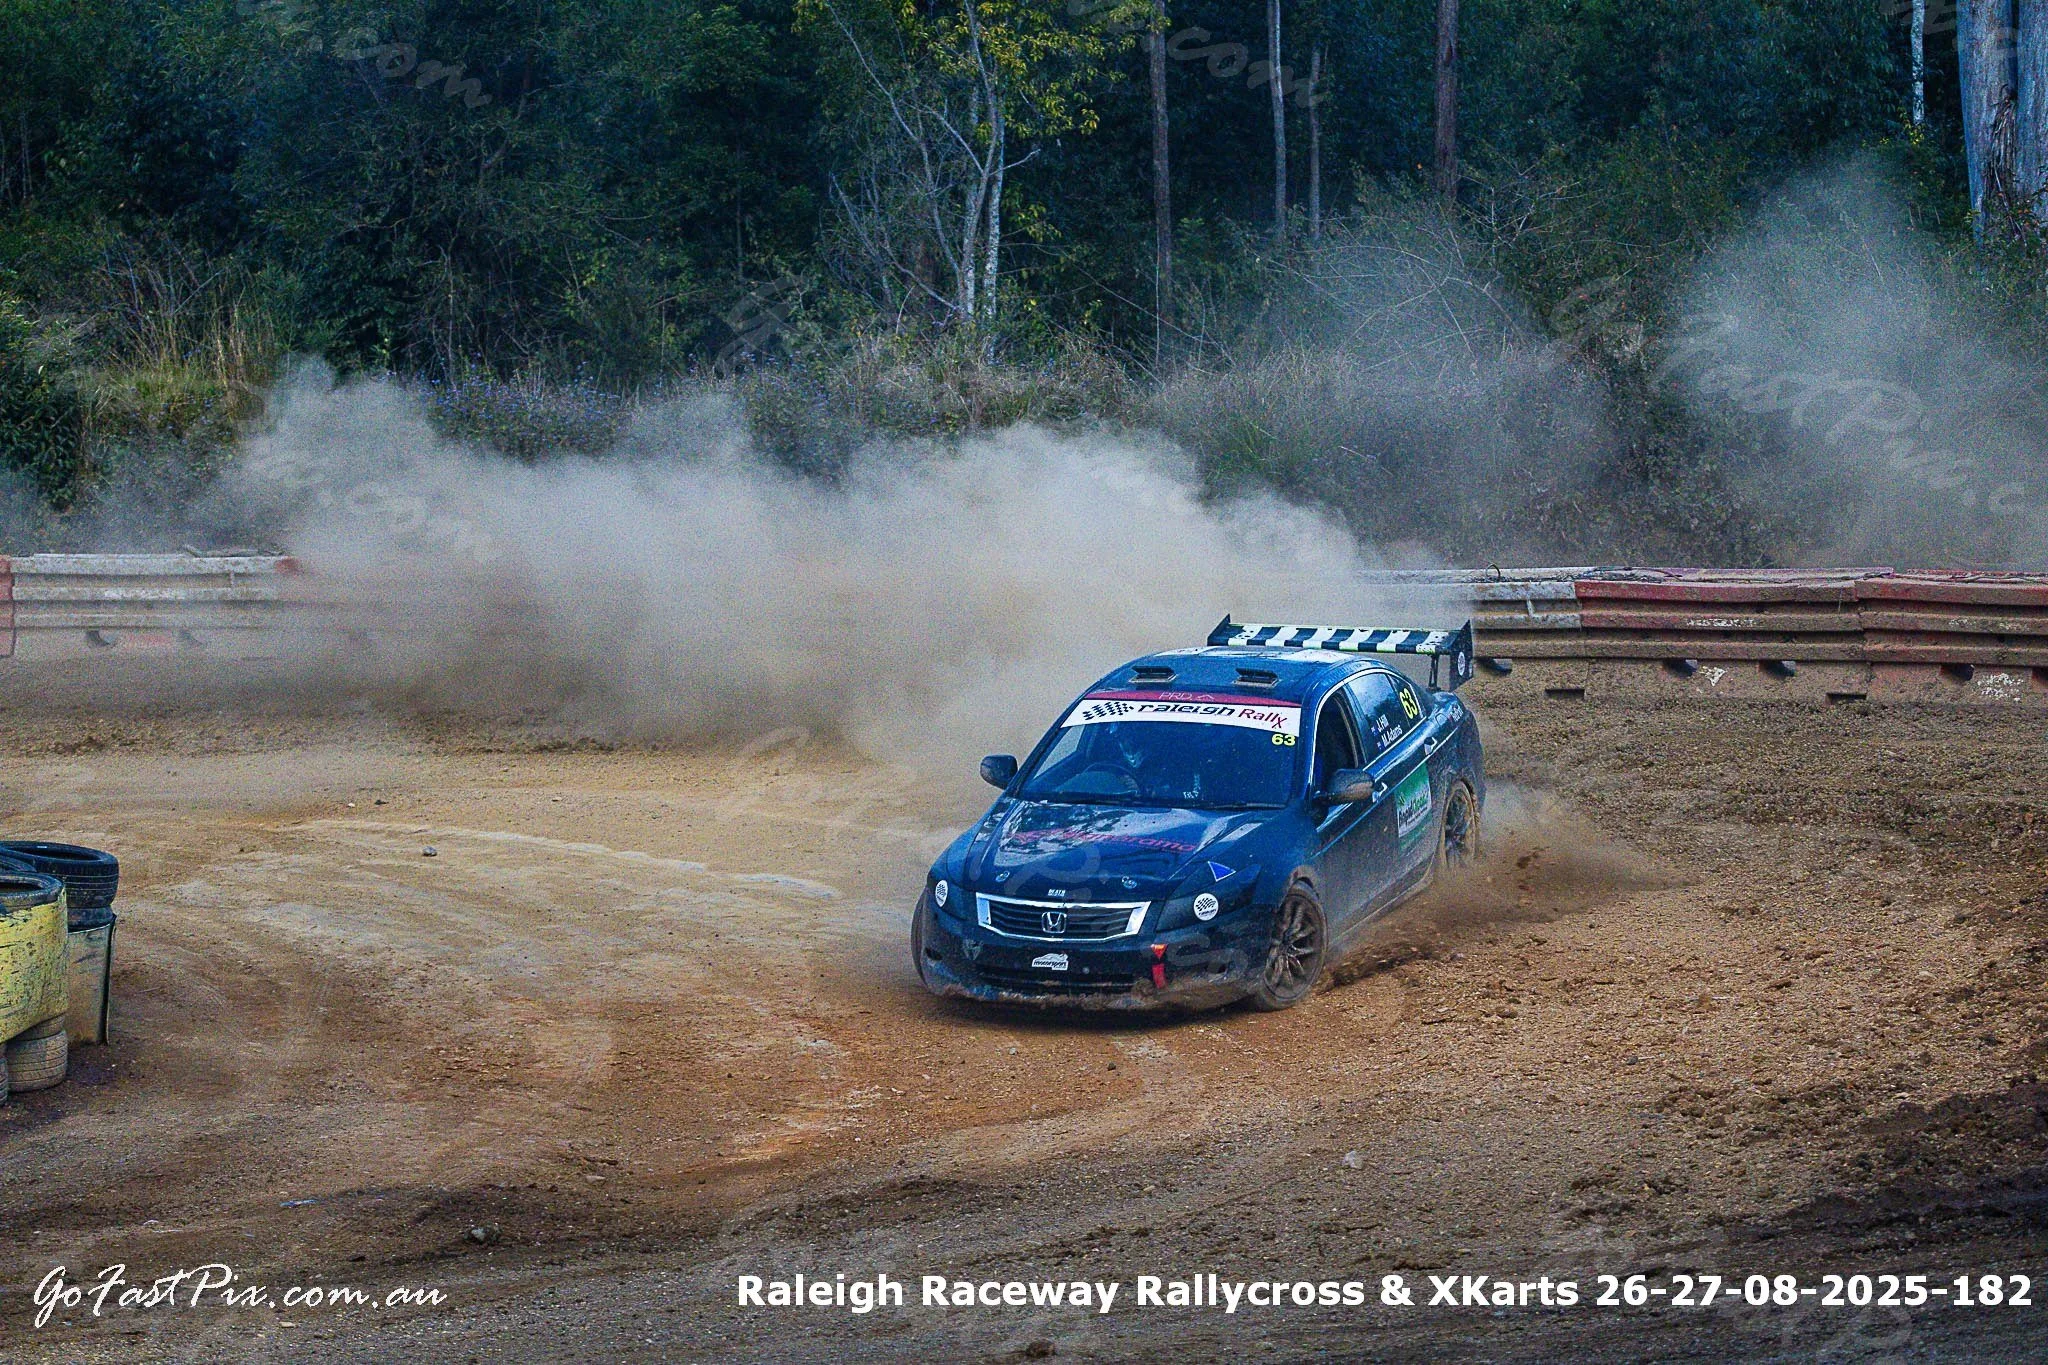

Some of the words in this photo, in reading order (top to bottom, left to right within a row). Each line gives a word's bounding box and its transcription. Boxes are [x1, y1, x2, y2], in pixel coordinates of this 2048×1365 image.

[1138, 703, 1236, 716] raleigh
[1399, 687, 1418, 719] 63
[1271, 733, 1296, 747] 63
